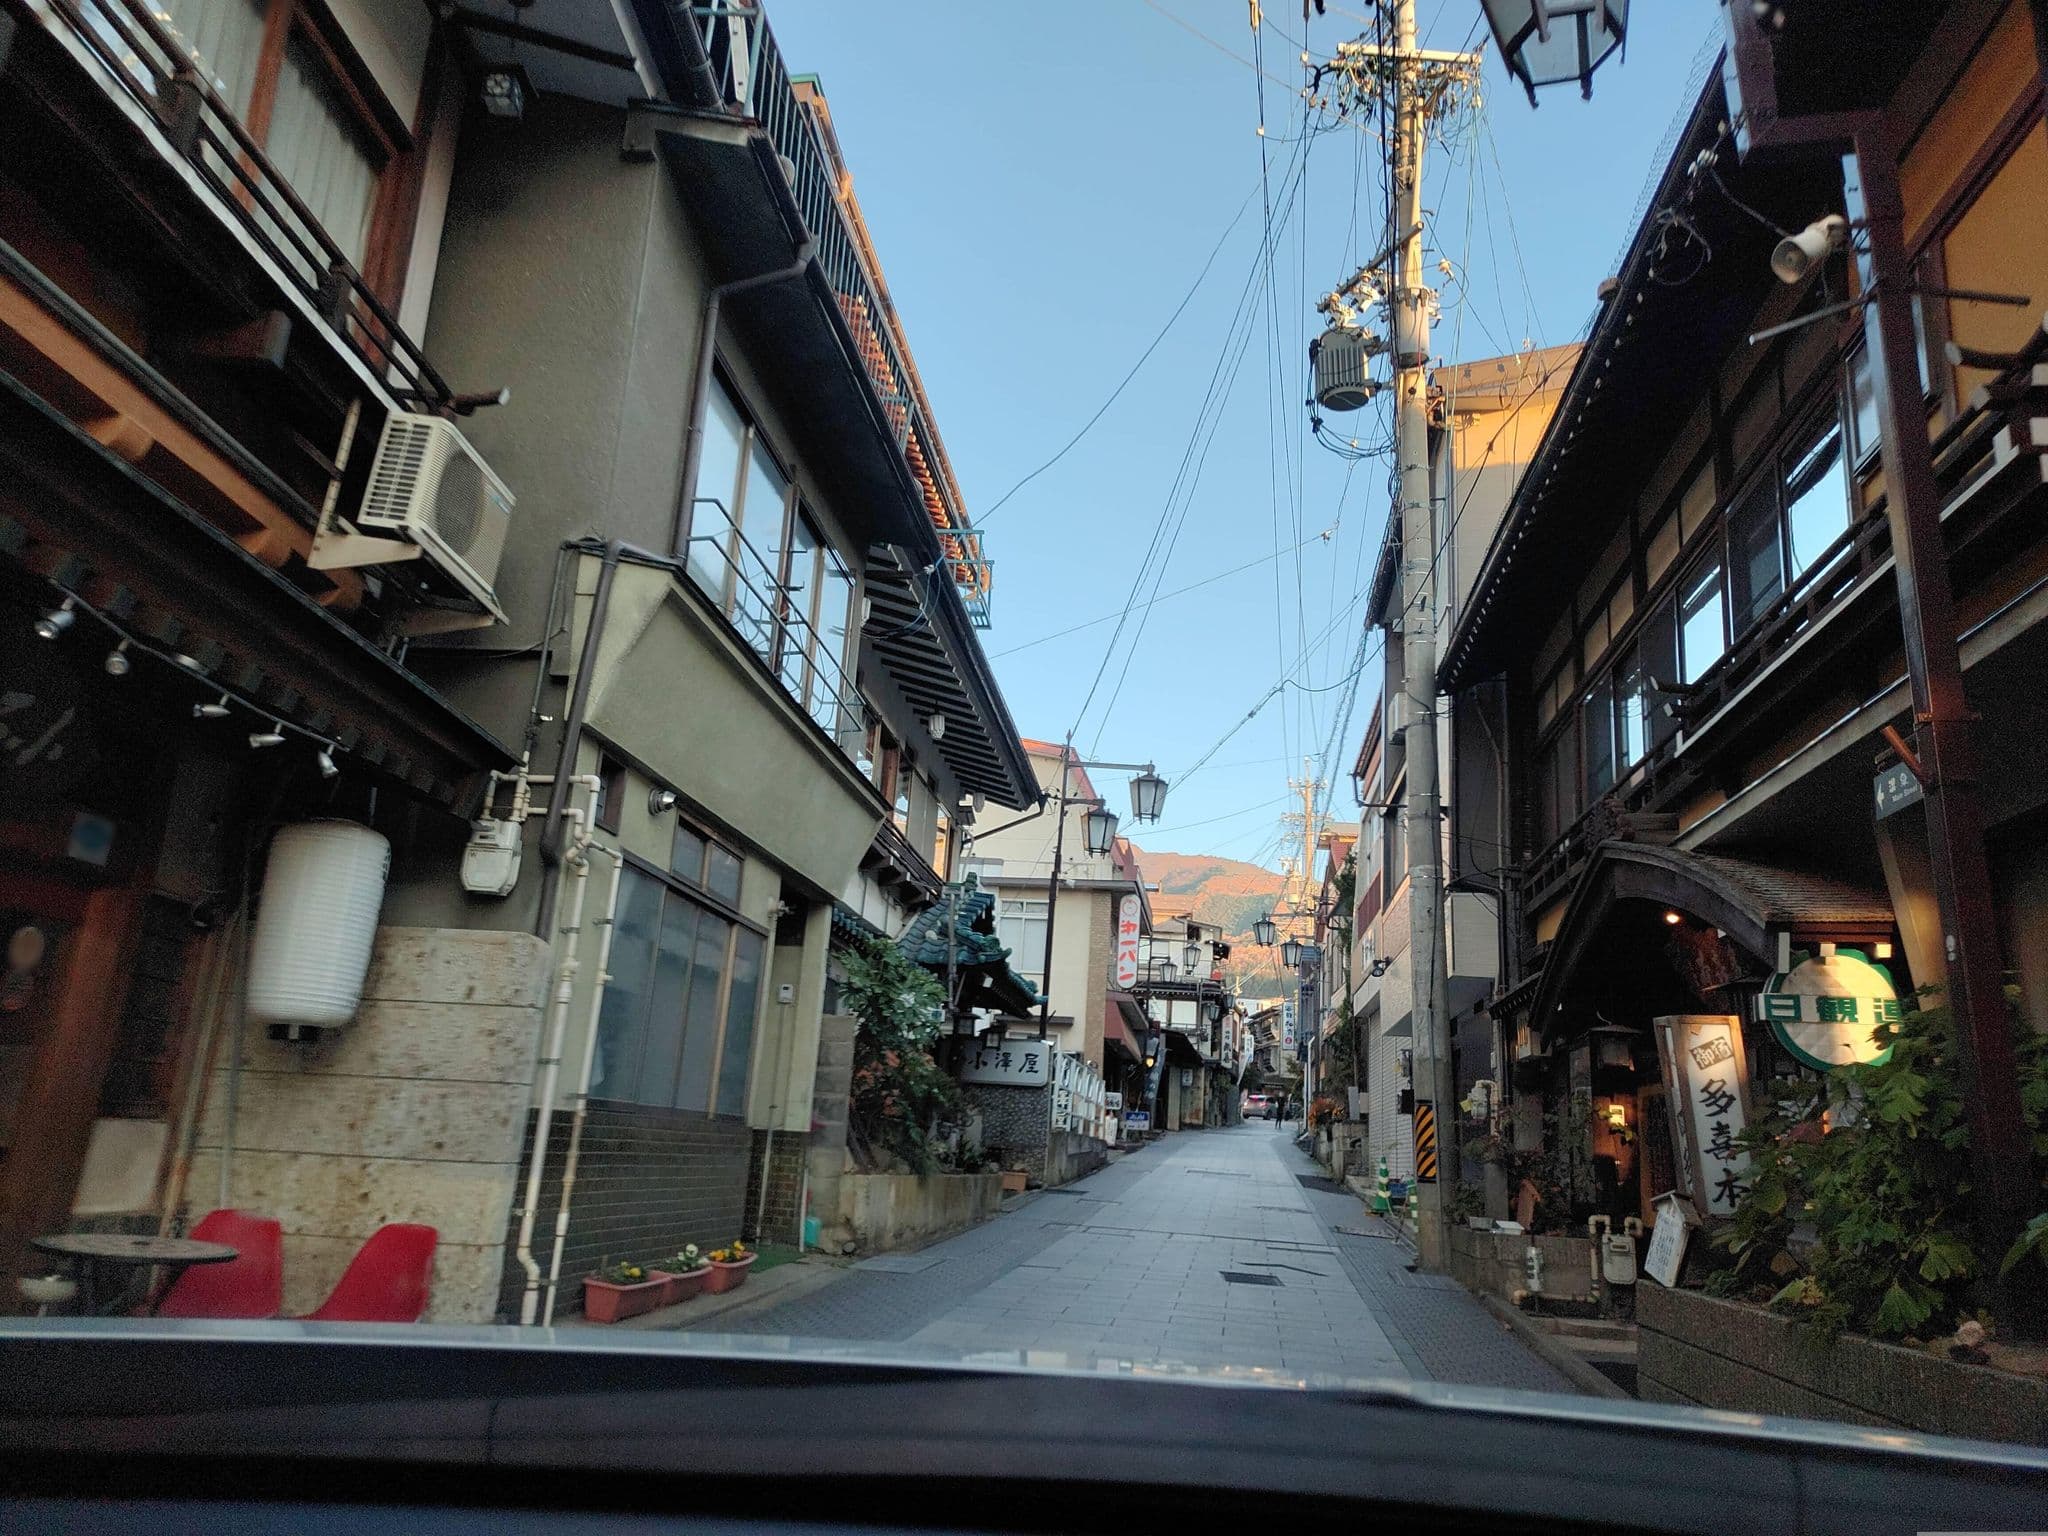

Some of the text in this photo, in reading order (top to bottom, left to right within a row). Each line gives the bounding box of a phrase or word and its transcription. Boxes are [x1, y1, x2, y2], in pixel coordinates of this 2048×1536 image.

[967, 1051, 1040, 1074] 小澤屋
[1699, 1078, 1751, 1208] 多喜本
